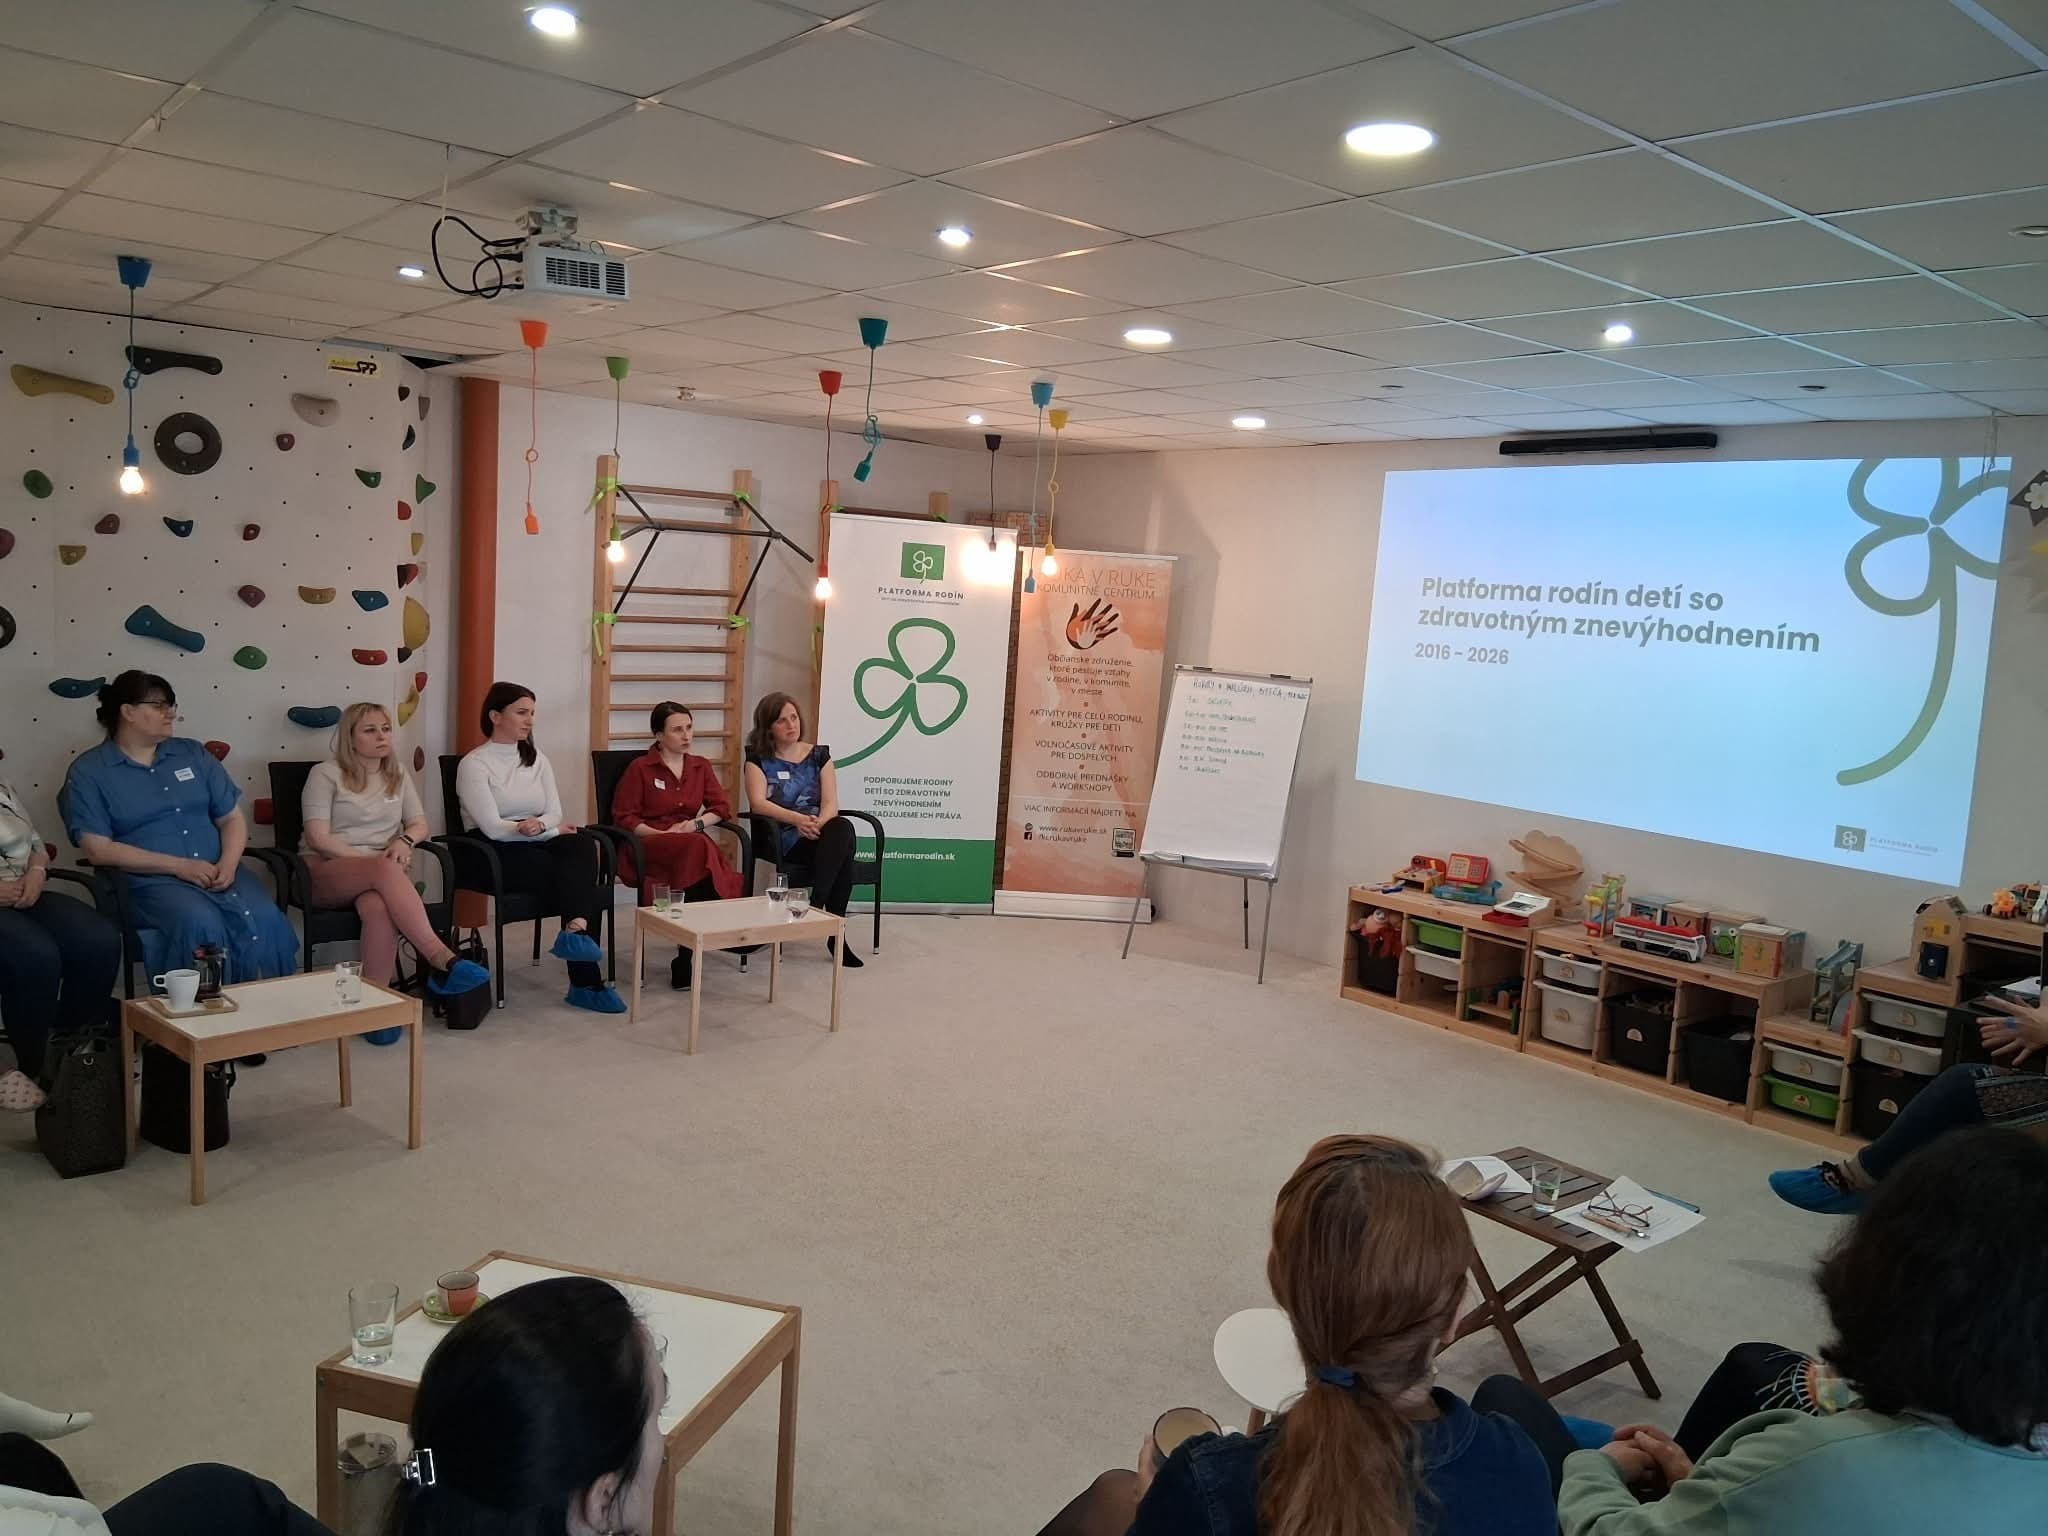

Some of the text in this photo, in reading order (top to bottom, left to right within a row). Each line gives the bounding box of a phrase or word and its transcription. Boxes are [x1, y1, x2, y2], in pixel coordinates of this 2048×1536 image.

[1091, 570, 1103, 585] V
[1107, 569, 1157, 589] RUKE
[878, 586, 964, 599] PLATFORMA RODÍN
[1103, 586, 1155, 600] CENTRUM
[1422, 577, 1724, 611] Platforma rodín detí so
[1418, 606, 1820, 652] zdravotným znevýhodnením
[1415, 643, 1451, 660] 2016
[1467, 647, 1509, 665] 2026
[1030, 709, 1065, 720] AKTIVITY
[1067, 711, 1082, 720] PRE
[1085, 721, 1100, 730] PRE
[1099, 744, 1134, 753] AKTIVITY
[1051, 751, 1066, 759] PRE
[864, 776, 953, 786] PODPORUJEME RODINY
[865, 787, 882, 795] DETÍ
[1059, 783, 1112, 792] WORKSHOPY
[1024, 805, 1041, 813] VIAC
